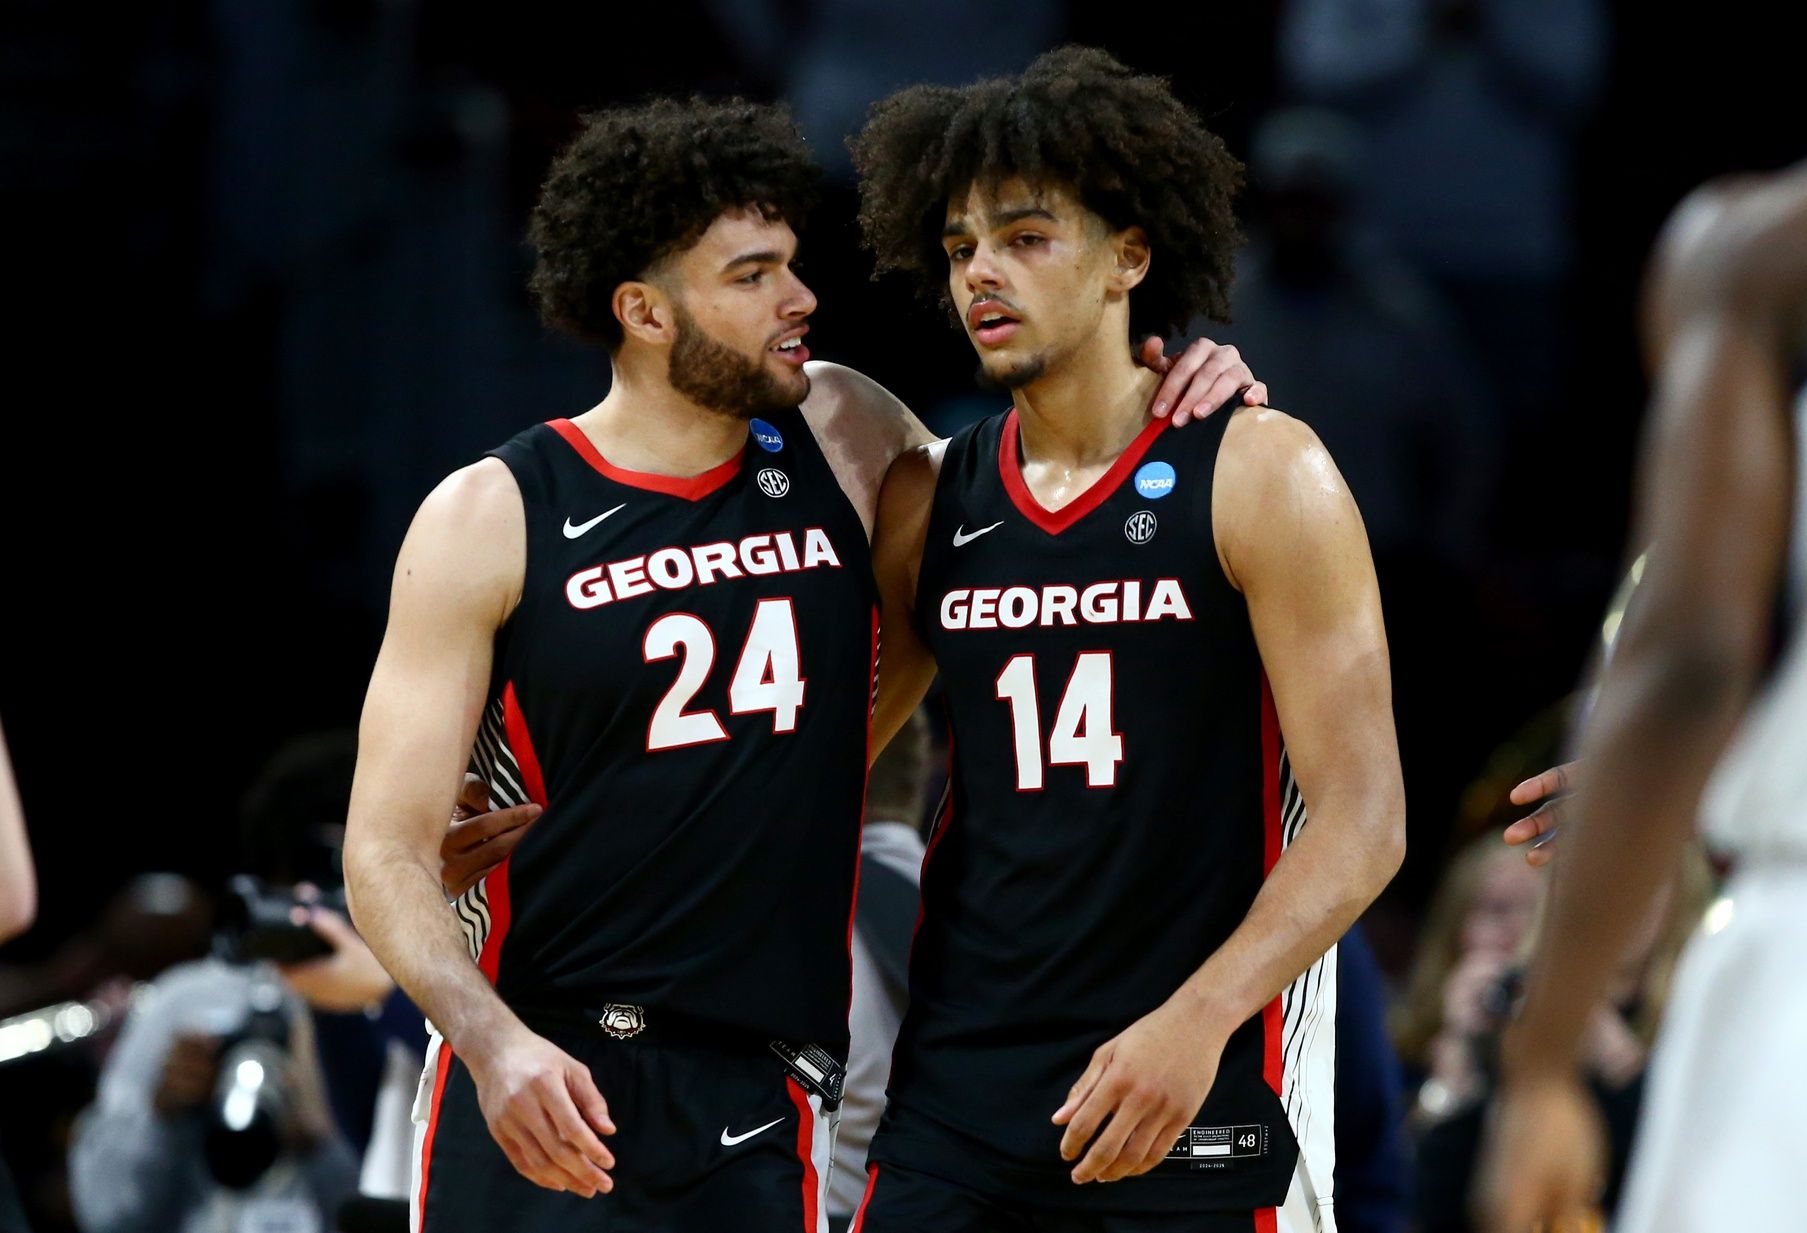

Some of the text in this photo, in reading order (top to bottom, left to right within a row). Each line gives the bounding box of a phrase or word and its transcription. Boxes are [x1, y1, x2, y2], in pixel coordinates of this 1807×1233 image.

[760, 470, 787, 495] SEC
[1140, 479, 1173, 489] NCAA
[1128, 513, 1155, 541] SEC
[565, 527, 841, 610] GEORGIA
[939, 578, 1196, 630] GEORGIA
[642, 596, 808, 752] 24
[994, 650, 1124, 791] 14
[1238, 1134, 1256, 1148] 48
